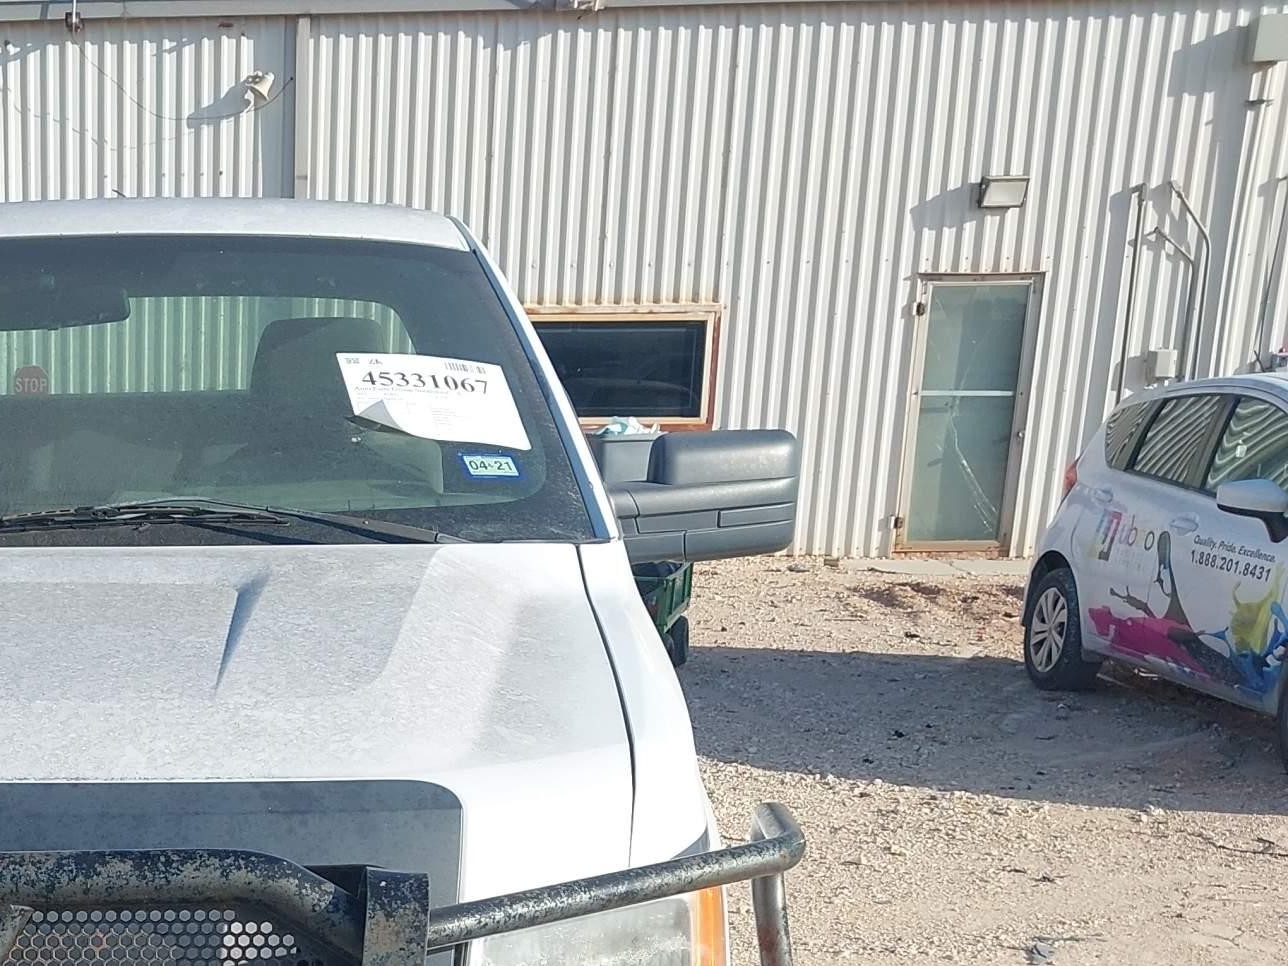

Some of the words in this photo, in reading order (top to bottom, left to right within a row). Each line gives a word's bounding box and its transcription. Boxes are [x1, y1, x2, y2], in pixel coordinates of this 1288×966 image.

[15, 377, 47, 393] STOP
[361, 370, 488, 395] 45331067
[1191, 549, 1272, 582] 1.888.201.8431
